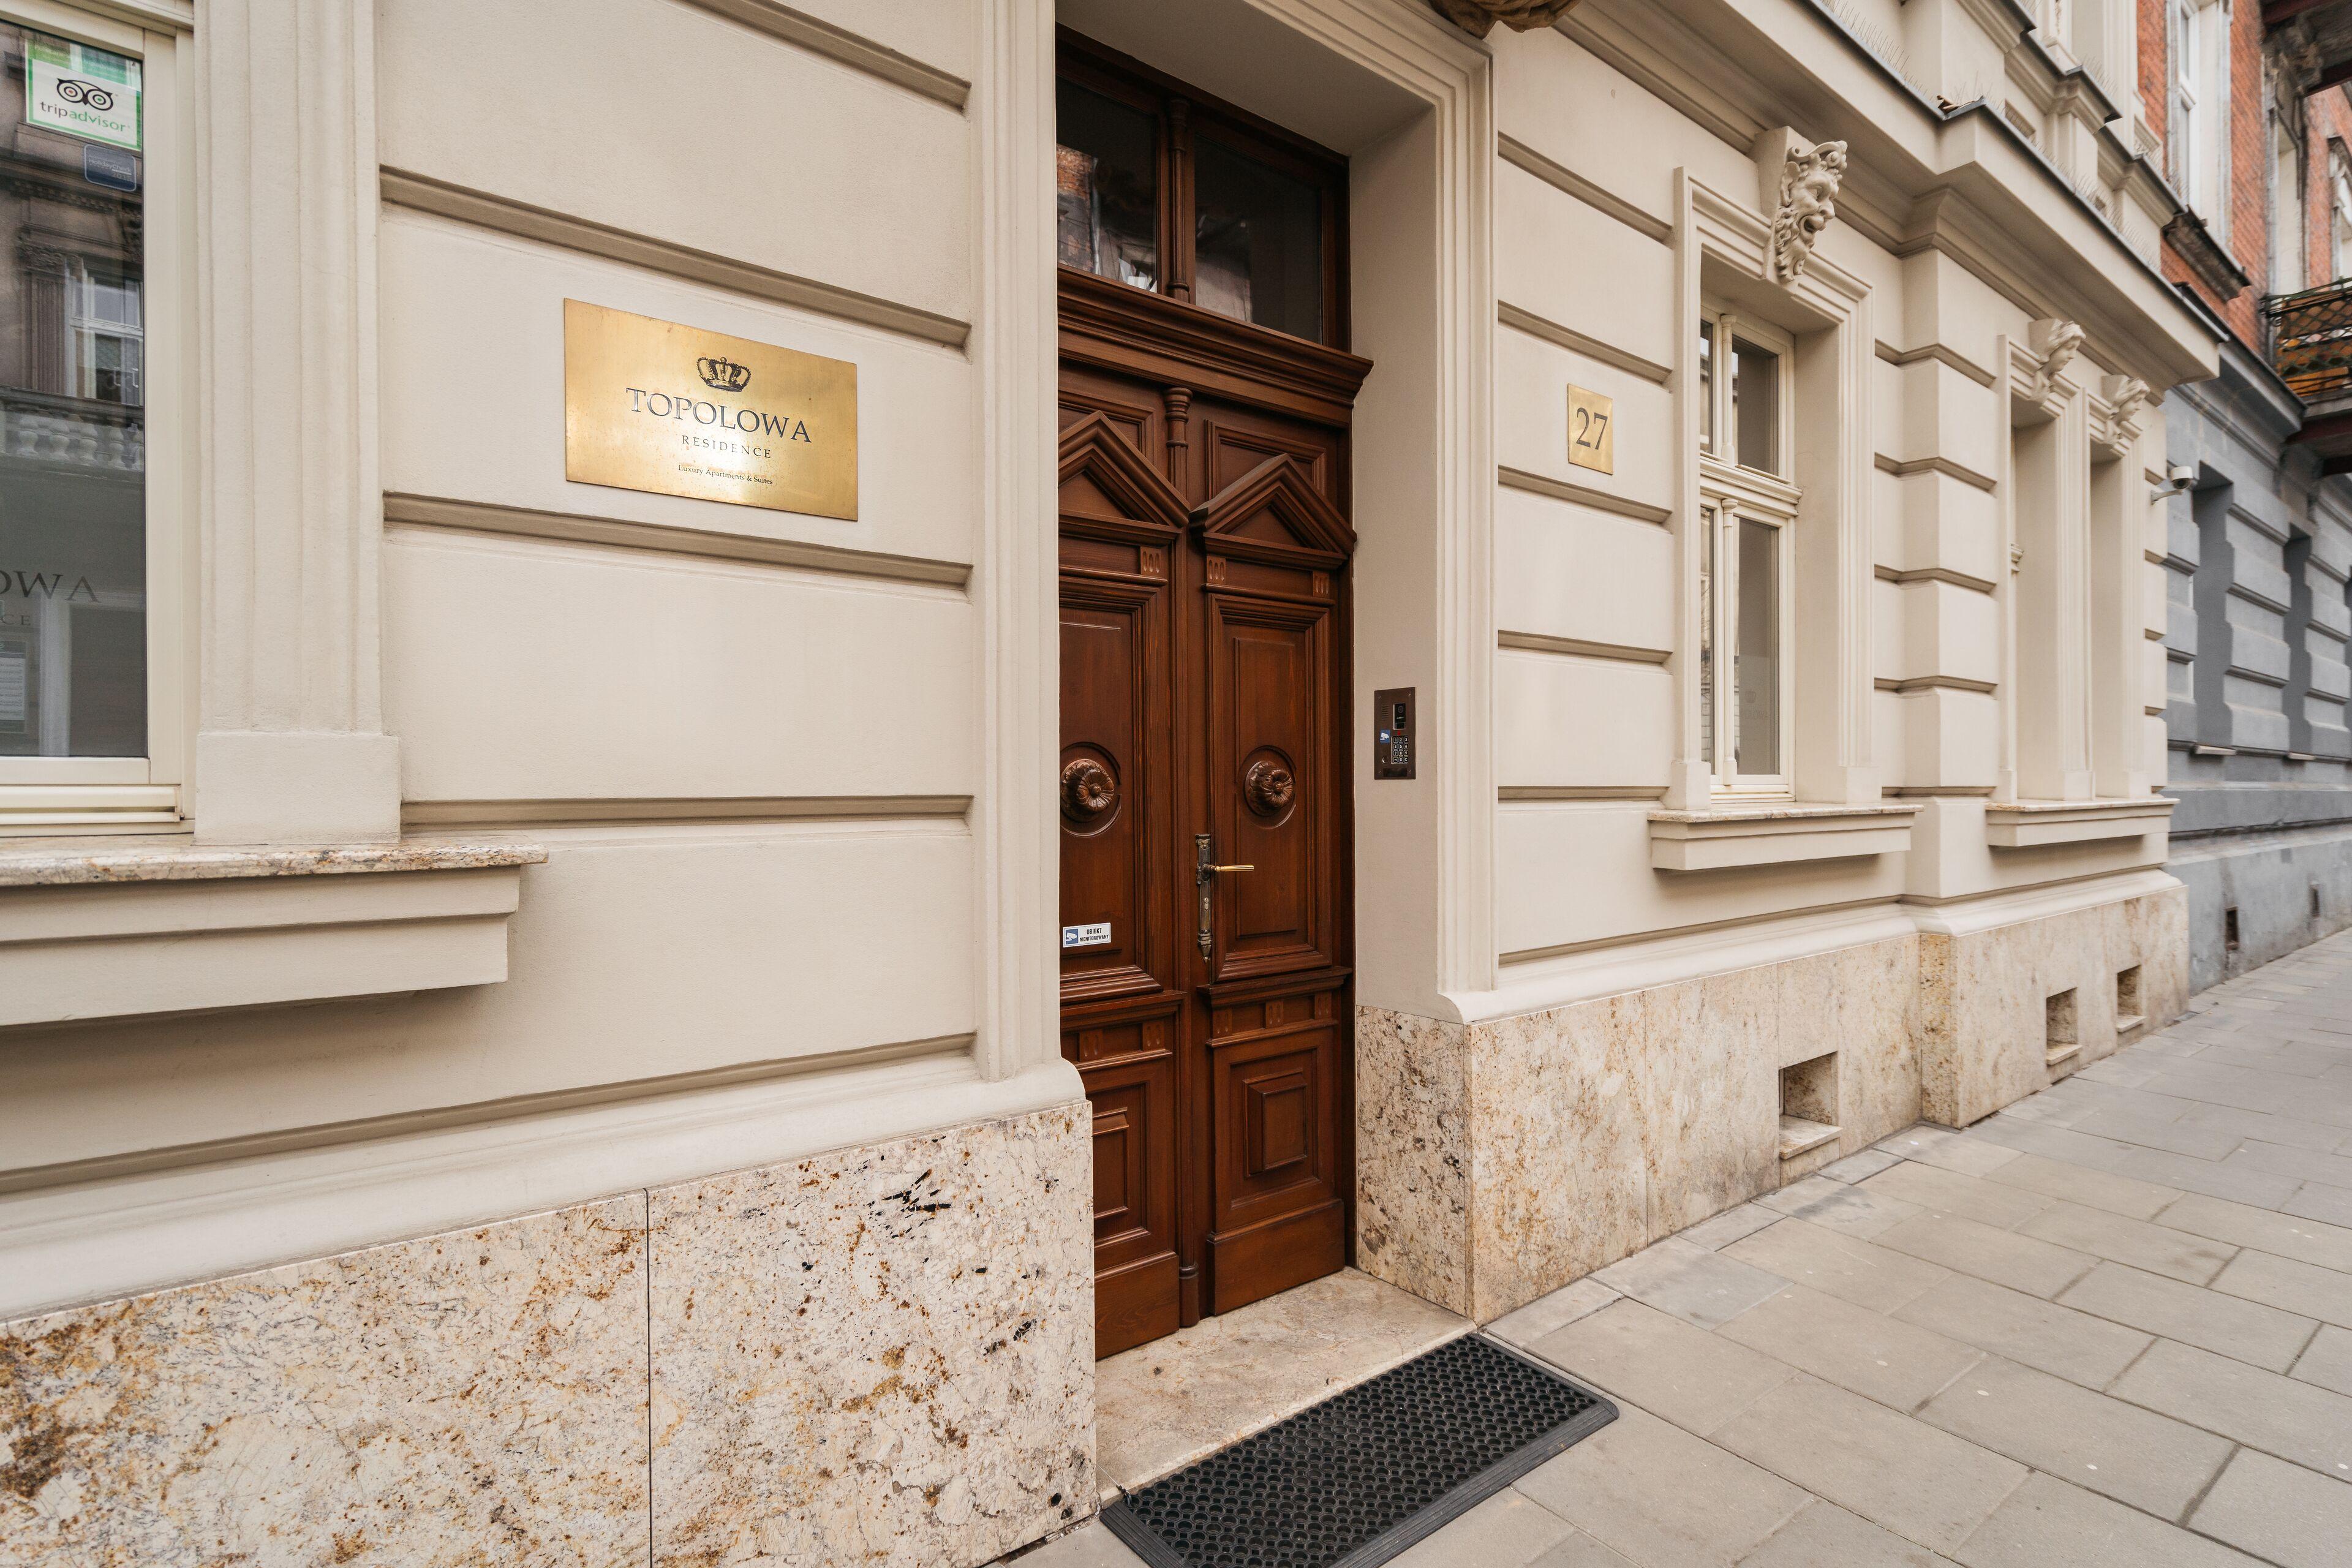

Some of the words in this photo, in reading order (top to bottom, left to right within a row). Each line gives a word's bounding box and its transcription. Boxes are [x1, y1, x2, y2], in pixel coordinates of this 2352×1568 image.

[40, 101, 126, 132] tripadvisor
[626, 387, 812, 443] TOPOLOWA
[1576, 407, 1608, 450] 27
[681, 435, 771, 458] RESIDENCE
[678, 464, 703, 475] Luxury
[706, 469, 745, 481] Apartments
[753, 476, 773, 484] Suites
